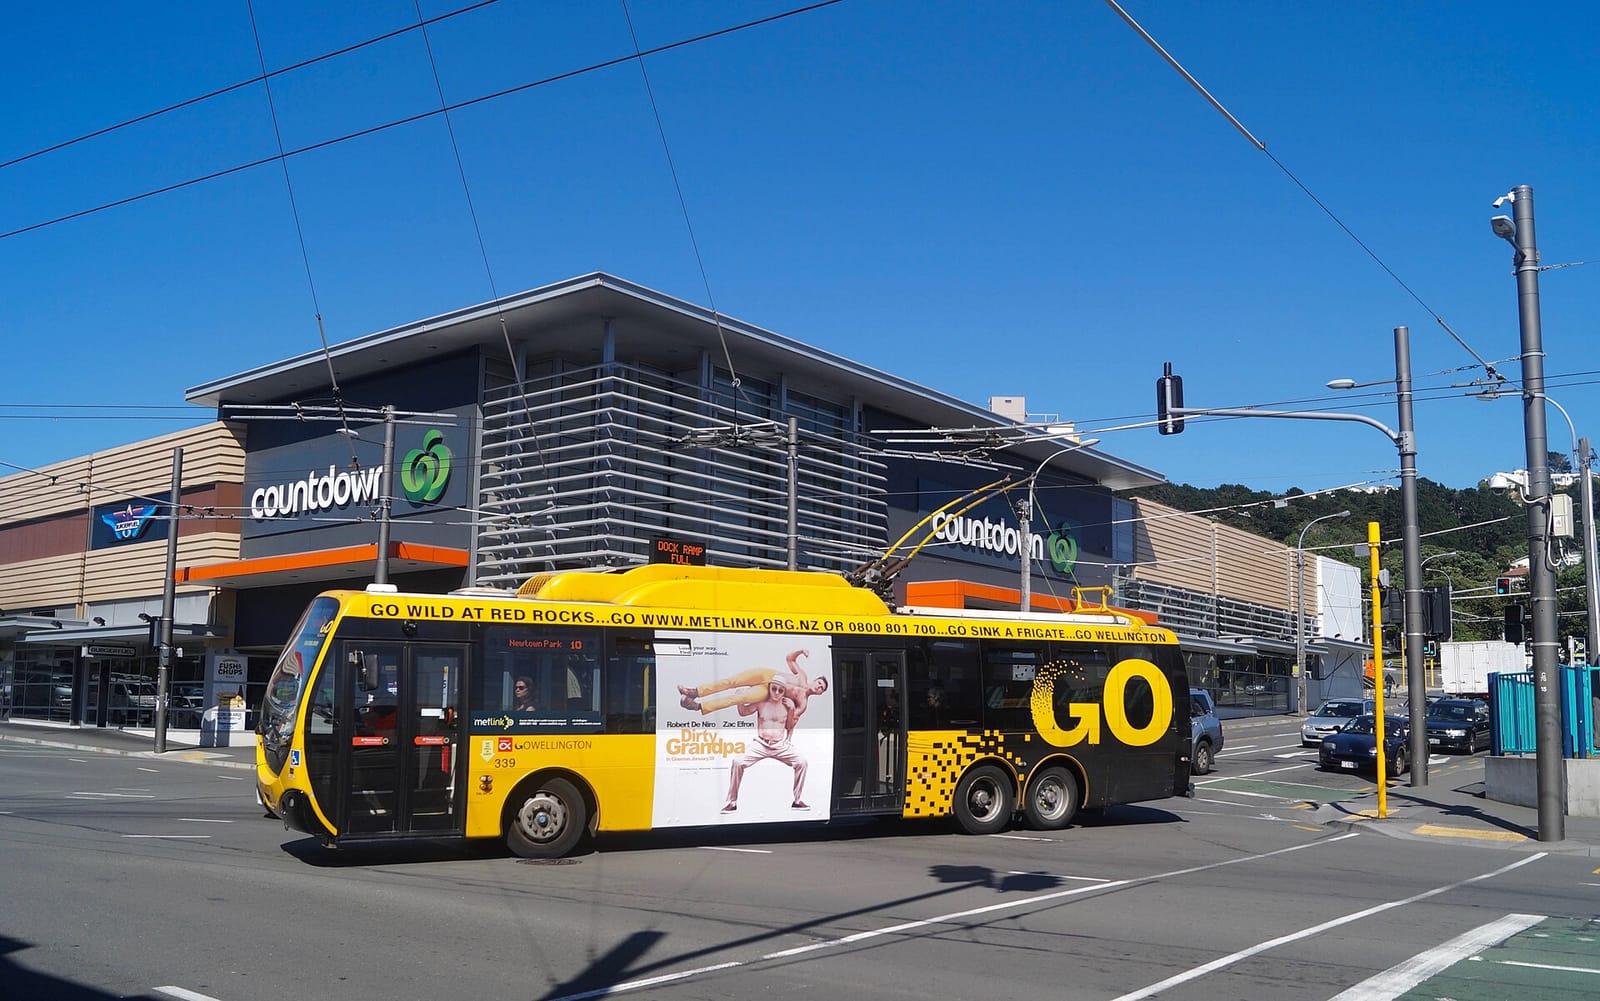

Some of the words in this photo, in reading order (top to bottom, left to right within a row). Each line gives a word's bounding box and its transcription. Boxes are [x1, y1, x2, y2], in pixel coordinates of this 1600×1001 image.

[658, 541, 679, 552] DOCK
[683, 544, 703, 556] RAMP
[672, 554, 691, 566] FULL
[370, 603, 399, 617] GO
[407, 604, 454, 618] WILD
[461, 607, 484, 620] AT
[491, 608, 525, 622] RED
[641, 613, 819, 631] WWW.METLINK.ORG.NZ
[824, 620, 844, 632] OR
[849, 622, 881, 632] 0800
[886, 623, 908, 634] 801
[972, 626, 1001, 637] SINK
[1006, 628, 1014, 637] A
[1095, 631, 1167, 642] WELLINGTON
[509, 640, 542, 648] Newtown
[544, 640, 562, 648] Park
[570, 640, 582, 650] 10
[1031, 659, 1173, 748] GO
[474, 718, 504, 726] metlink
[681, 728, 717, 743] Dirty
[666, 738, 746, 758] Grandpa
[494, 758, 516, 768] 339
